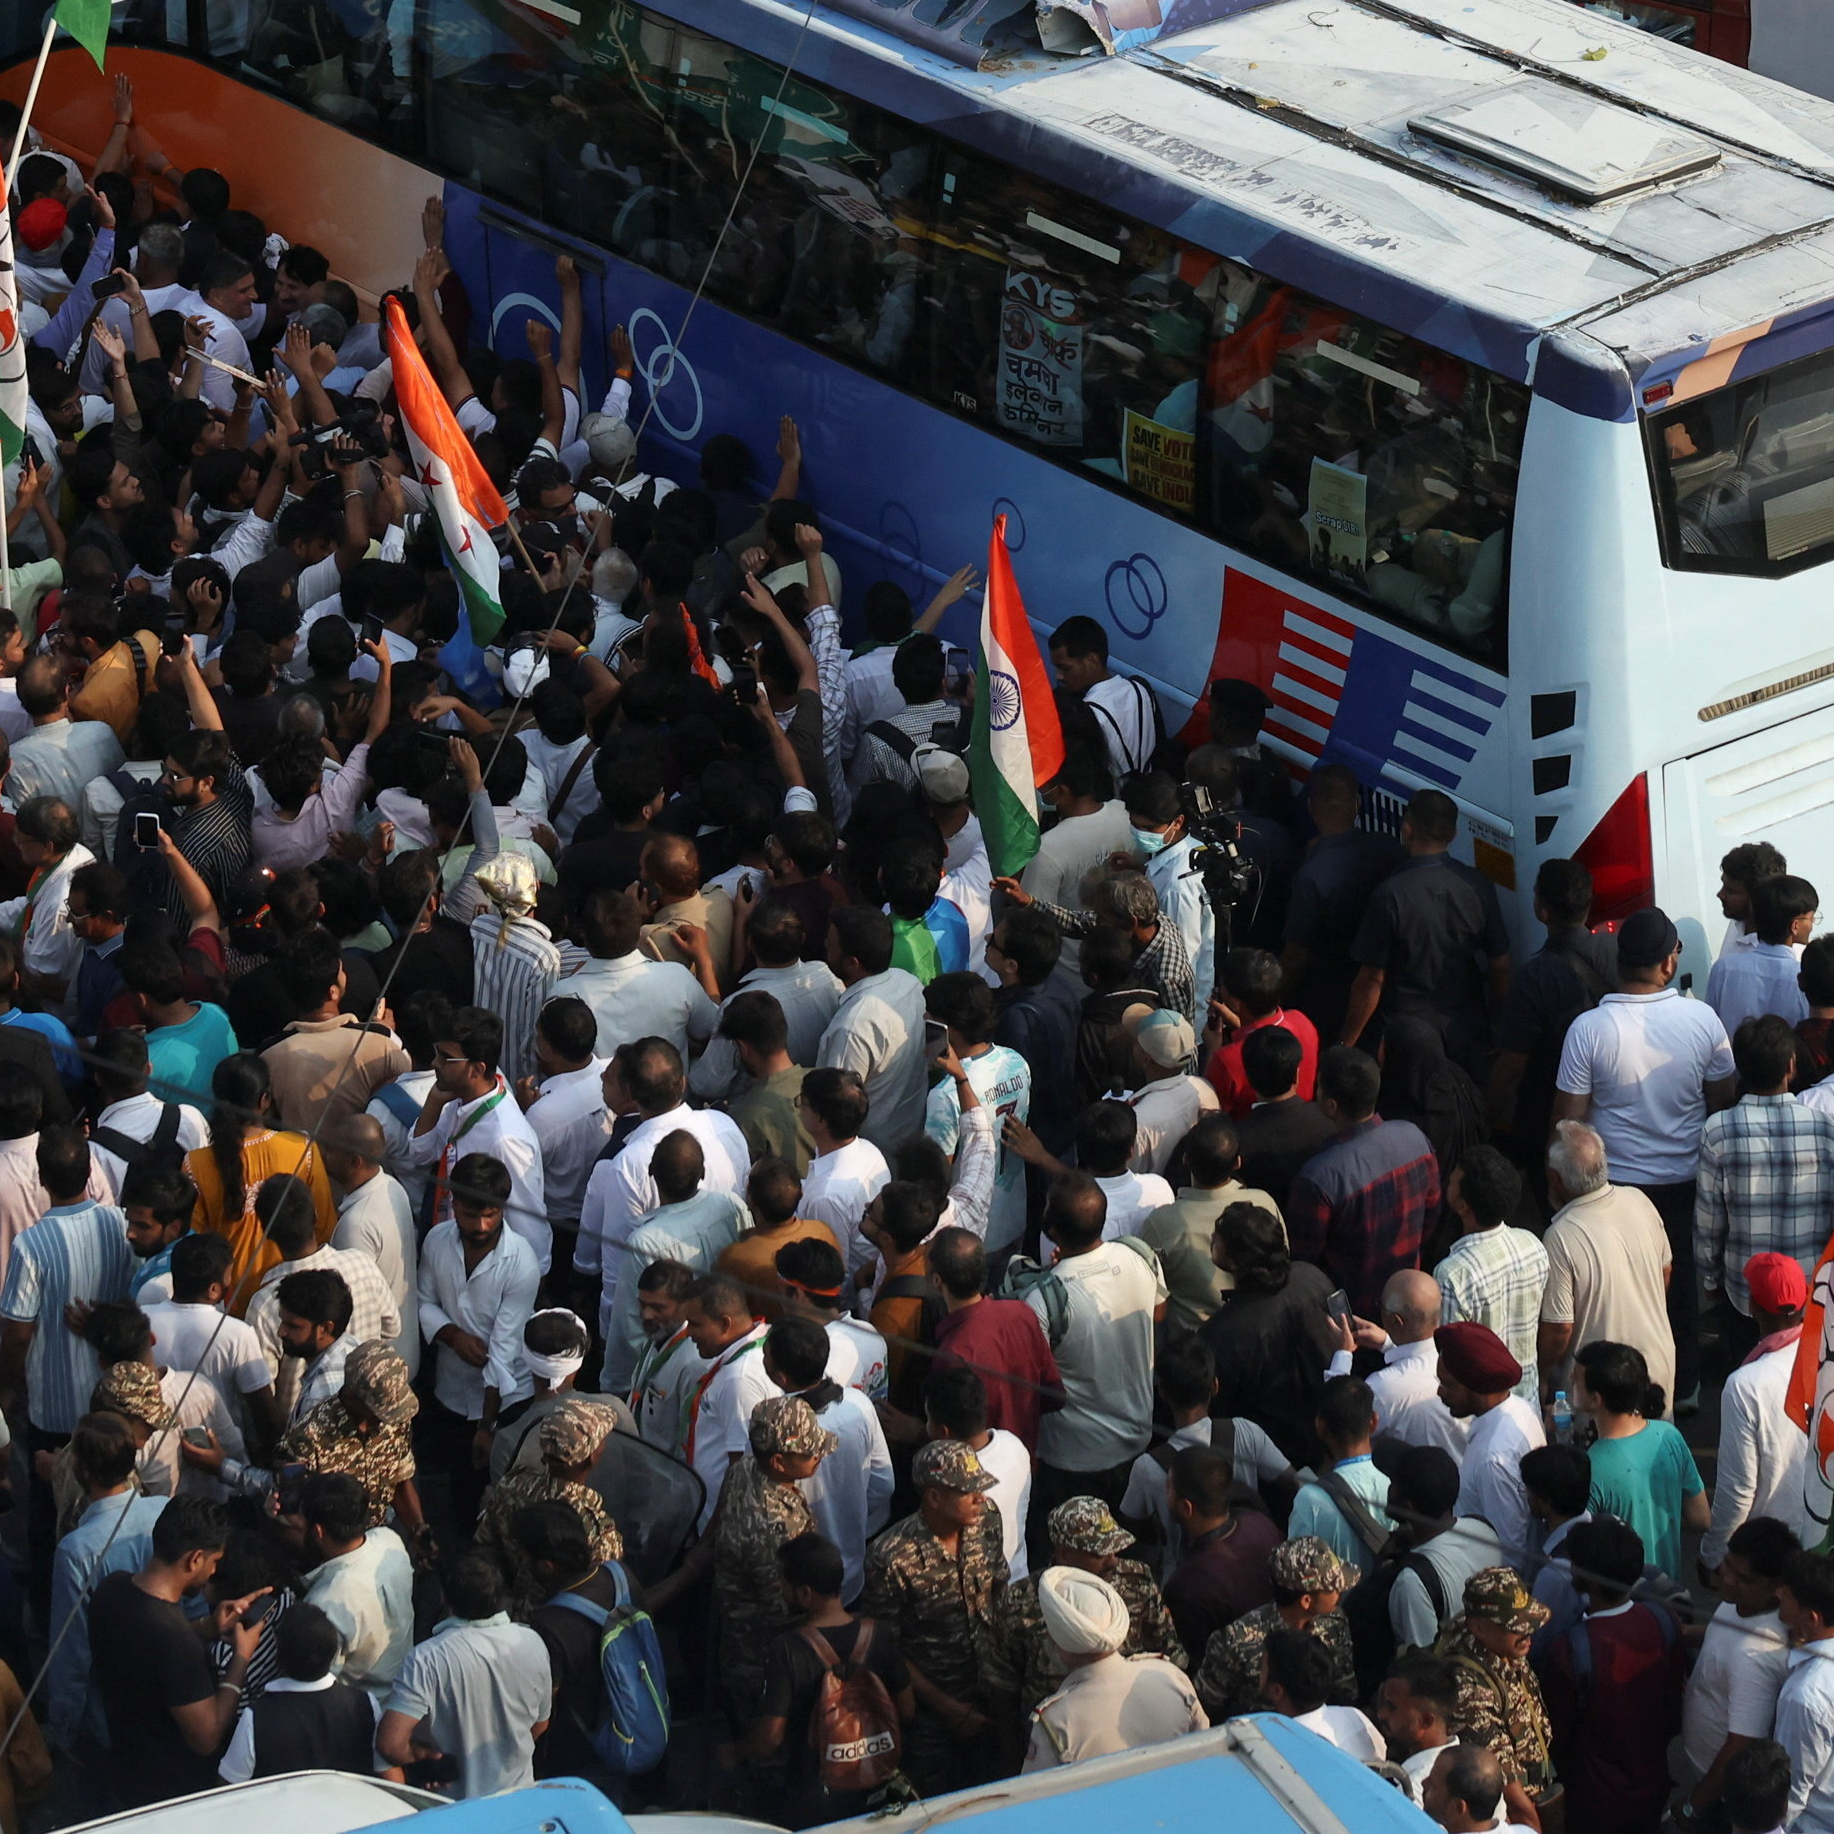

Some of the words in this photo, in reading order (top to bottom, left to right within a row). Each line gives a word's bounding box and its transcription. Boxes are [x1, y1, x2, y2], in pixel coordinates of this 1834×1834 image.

[1005, 269, 1078, 319] KYS
[1133, 425, 1161, 452] SAVE
[1133, 469, 1160, 495] SAVE
[1316, 511, 1341, 534] Scrap
[984, 1074, 1025, 1106] RONALDO
[831, 1736, 892, 1761] adidas
